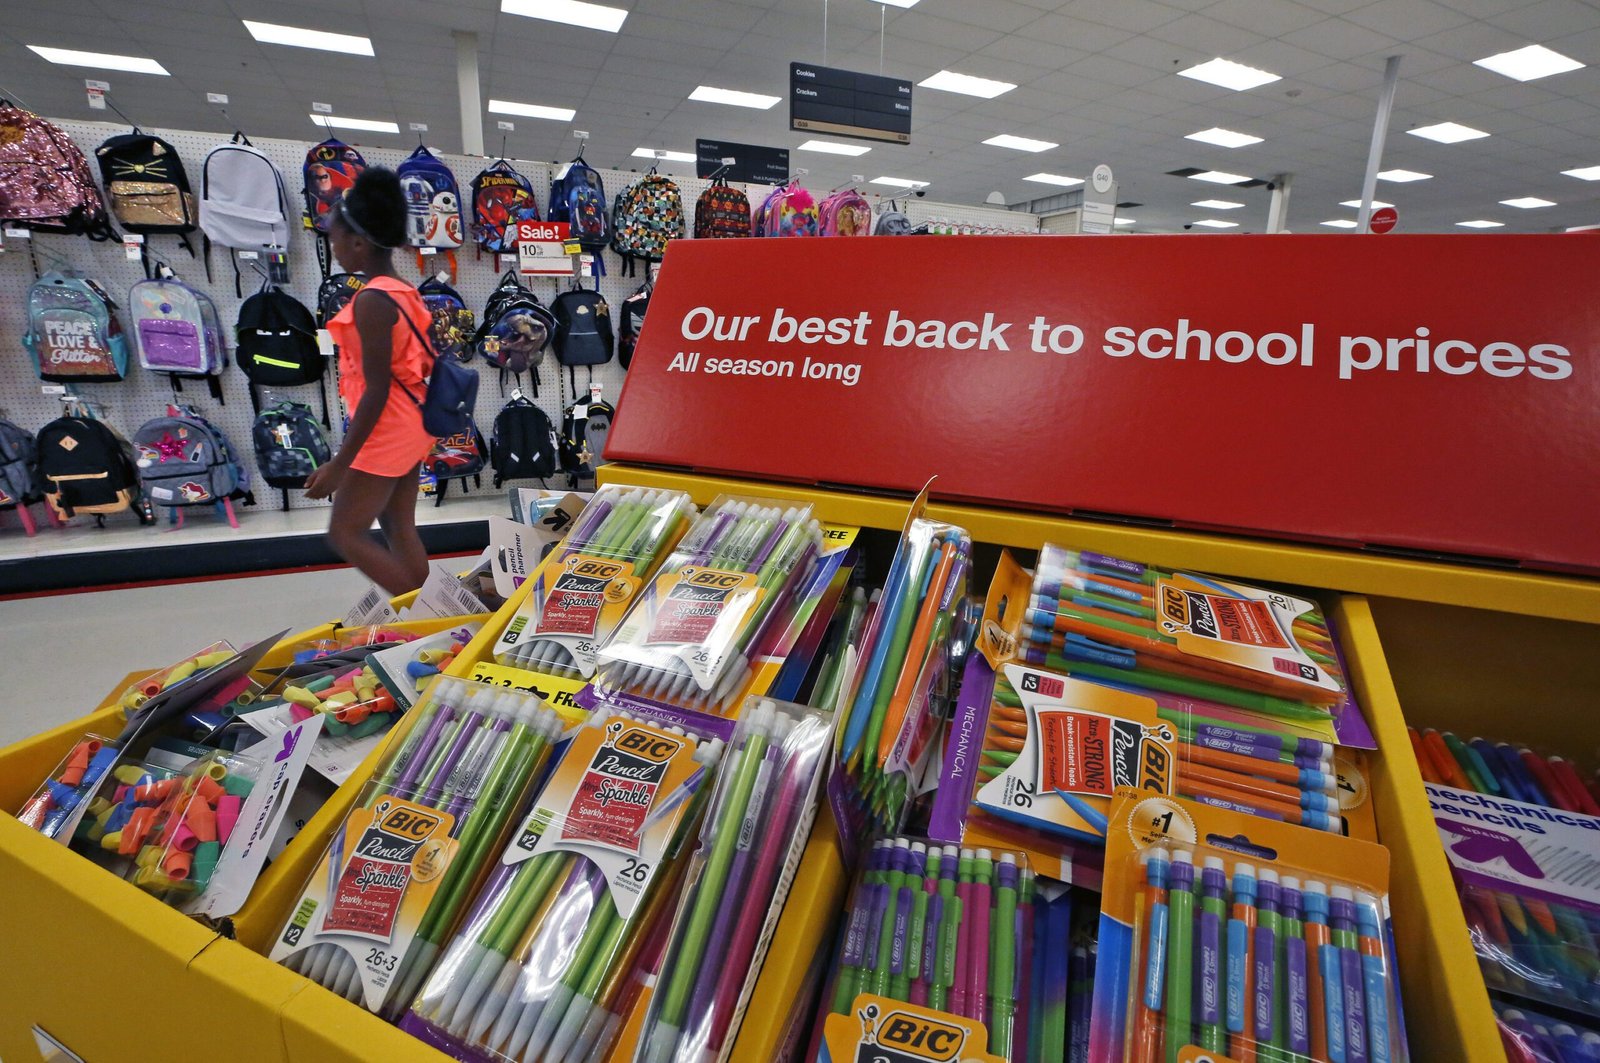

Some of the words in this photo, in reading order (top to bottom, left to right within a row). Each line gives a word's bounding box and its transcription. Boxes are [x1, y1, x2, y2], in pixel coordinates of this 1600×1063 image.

[796, 69, 815, 78] Cookies
[796, 88, 817, 96] Crackers
[520, 224, 559, 240] Sale!
[522, 244, 536, 256] 10
[44, 320, 92, 336] PEACE
[48, 335, 85, 348] LOVE
[88, 336, 99, 349] &
[681, 307, 760, 341] Our
[768, 308, 872, 346] best
[883, 310, 1012, 352] back
[1028, 316, 1084, 355] to
[1102, 318, 1314, 367] school
[1339, 326, 1573, 380] prices
[50, 348, 101, 364] Glitter
[667, 352, 701, 373] All
[704, 357, 794, 377] season
[801, 357, 861, 386] long
[508, 548, 518, 574] pencil
[515, 532, 525, 575] sharpener
[560, 578, 606, 591] Pencil
[675, 588, 724, 600] Pencil
[559, 592, 600, 611] Sparkle
[673, 602, 721, 619] Sparkle
[1190, 596, 1218, 634] Pencil
[506, 633, 516, 642] #2
[1024, 676, 1037, 690] #2
[951, 706, 976, 779] MECHANICAL
[1084, 736, 1105, 790] STRONG
[1112, 725, 1134, 786] Pencil
[272, 762, 288, 790] cap
[596, 755, 656, 780] Pencil
[594, 778, 650, 807] Sparkle
[1014, 778, 1034, 808] 26
[1336, 774, 1356, 794] #1
[579, 806, 604, 818] Sparkly,
[1152, 812, 1174, 834] #1
[242, 794, 274, 859] erasers
[360, 837, 416, 860] Pencil
[522, 834, 536, 848] #2
[355, 862, 406, 893] Sparkle
[620, 858, 650, 882] 26
[340, 894, 362, 906] Sparkly,
[288, 928, 300, 942] #2
[365, 948, 398, 972] 26+3
[1204, 979, 1214, 1004] BIC
